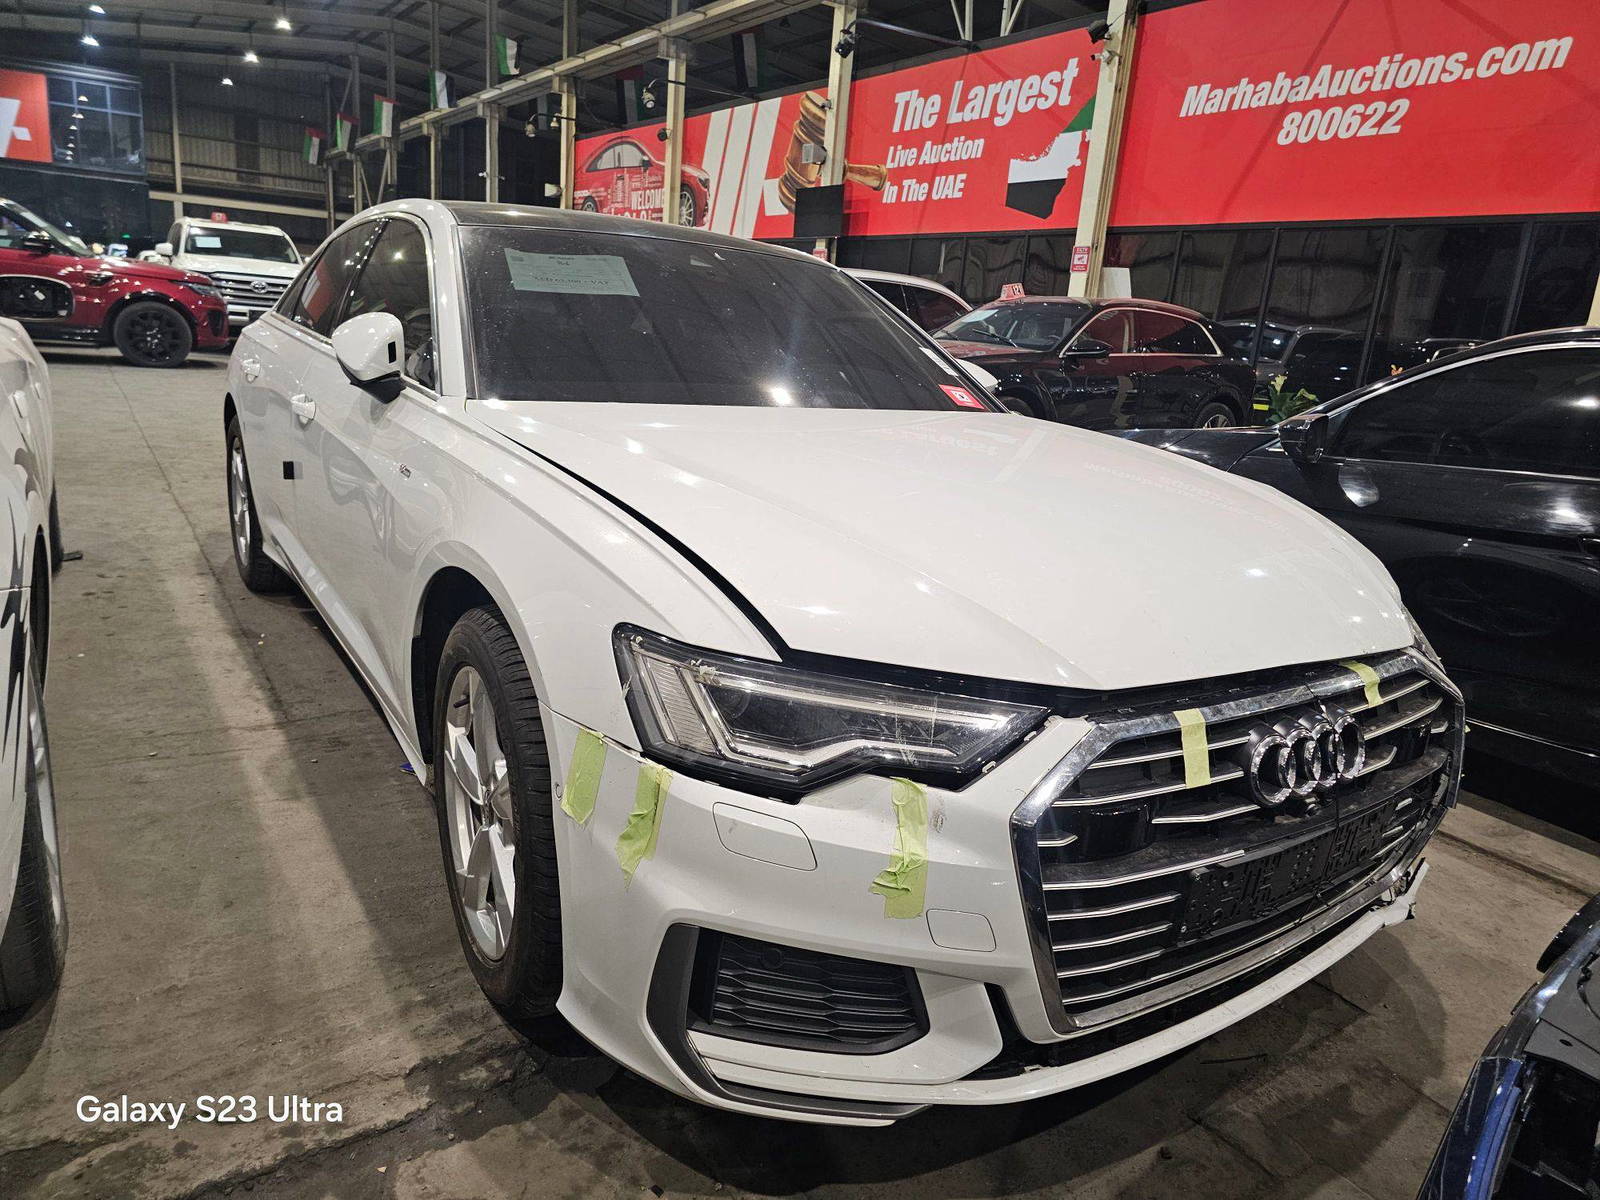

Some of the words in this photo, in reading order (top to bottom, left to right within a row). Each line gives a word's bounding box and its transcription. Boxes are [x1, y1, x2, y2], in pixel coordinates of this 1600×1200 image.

[892, 89, 942, 133] The
[946, 57, 1079, 127] Largest
[1179, 36, 1573, 117] MarhabaAuctions.com
[1277, 99, 1410, 145] 800622
[885, 145, 917, 169] Live
[918, 136, 985, 166] Auction
[882, 182, 898, 204] In
[901, 179, 928, 202] The
[931, 173, 967, 199] UAE
